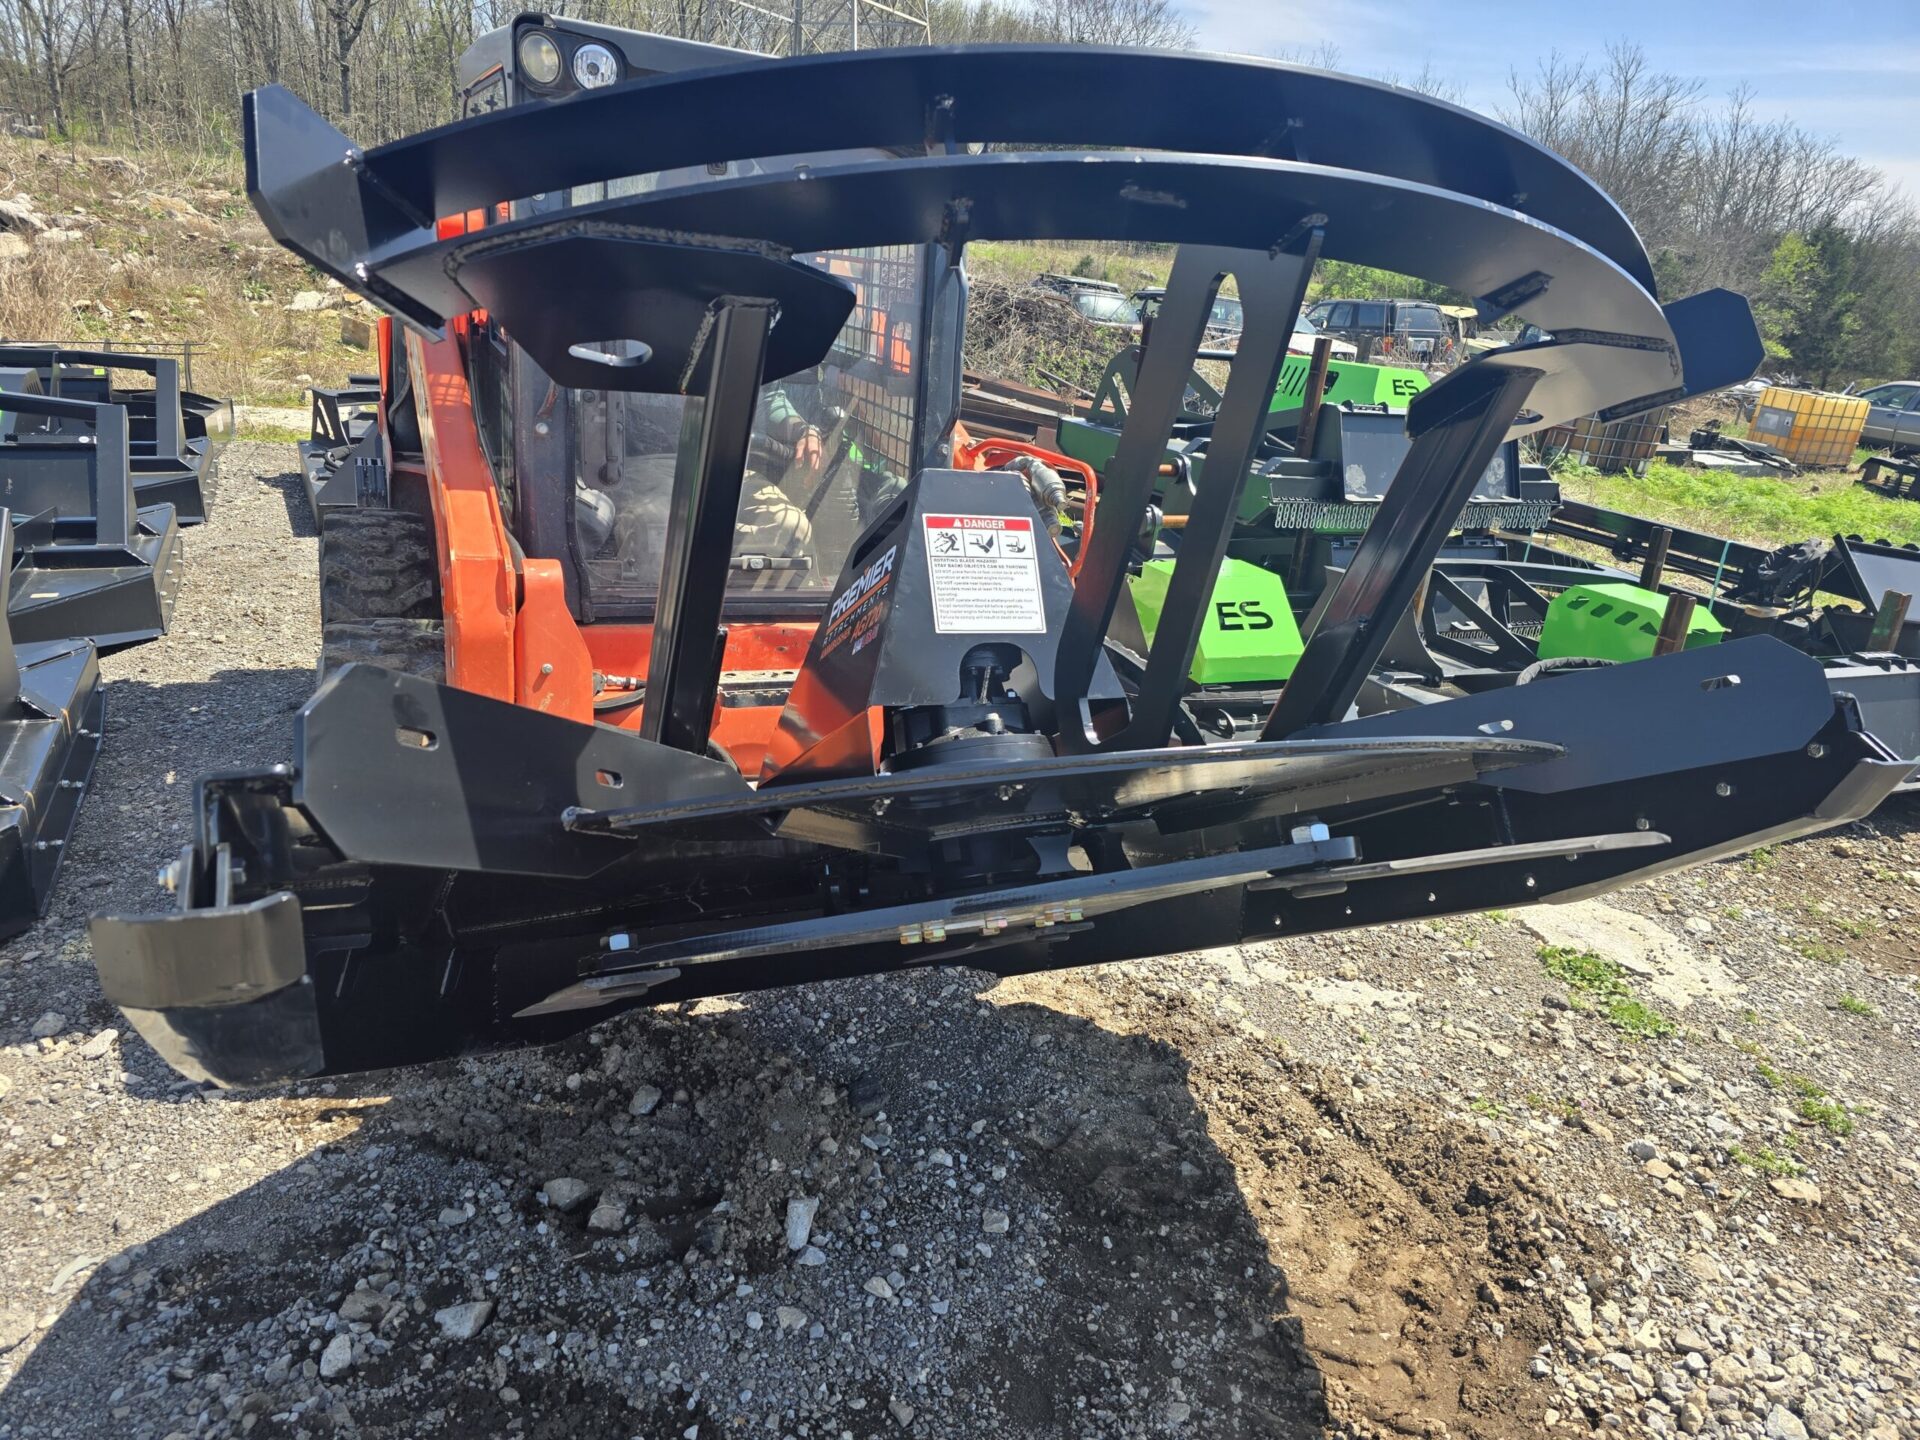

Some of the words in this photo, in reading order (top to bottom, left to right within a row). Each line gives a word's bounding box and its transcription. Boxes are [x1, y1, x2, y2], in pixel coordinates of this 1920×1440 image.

[1392, 379, 1420, 396] ES
[963, 519, 1006, 529] DANGER
[828, 545, 897, 627] PREMIER
[1216, 601, 1273, 631] ES
